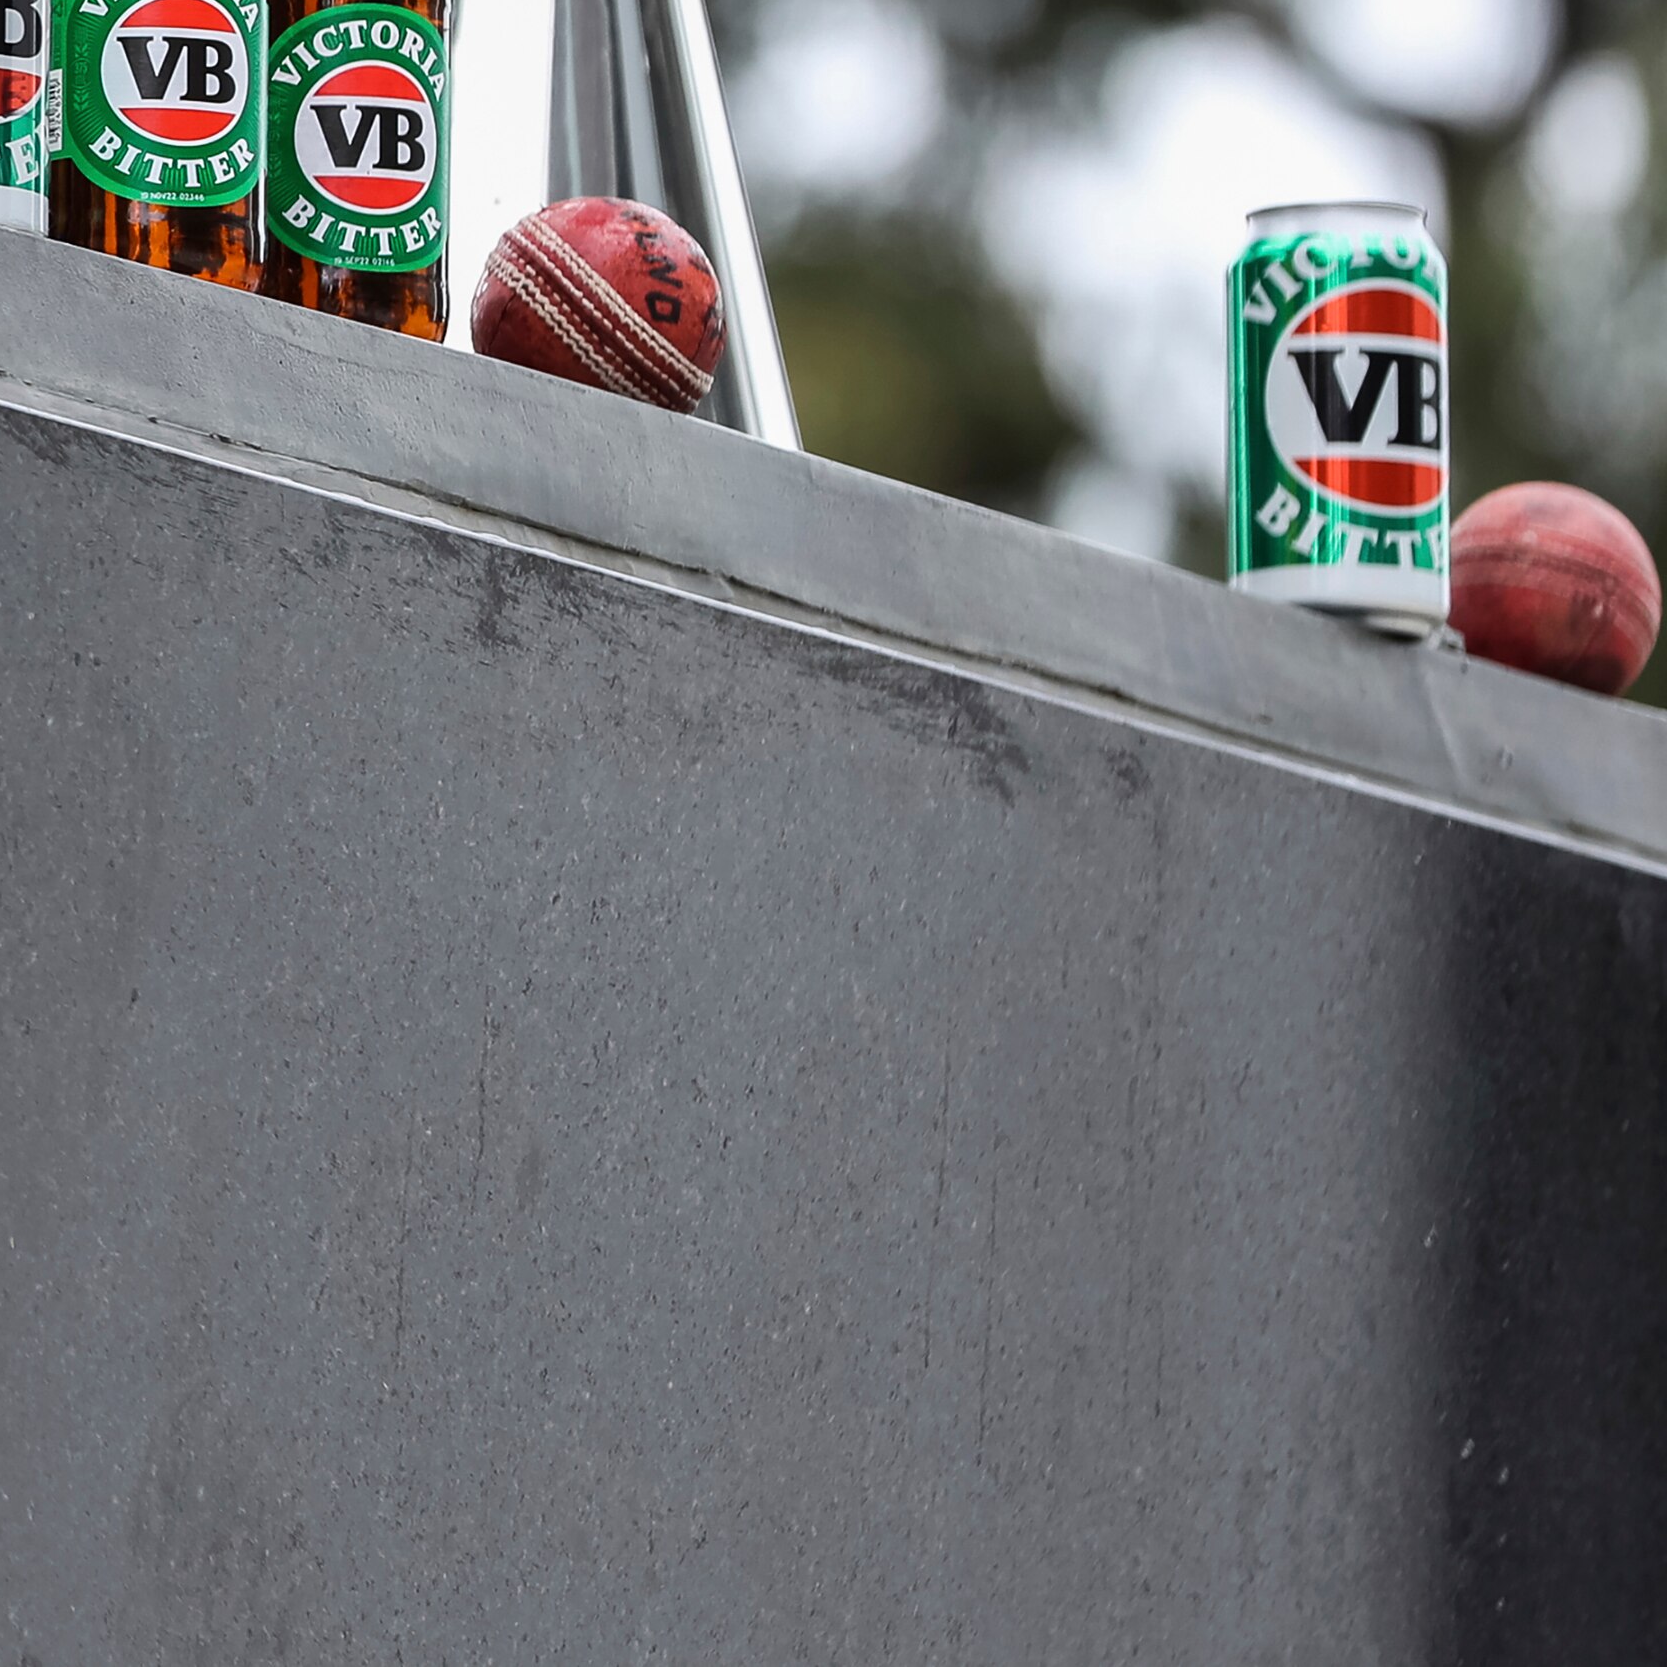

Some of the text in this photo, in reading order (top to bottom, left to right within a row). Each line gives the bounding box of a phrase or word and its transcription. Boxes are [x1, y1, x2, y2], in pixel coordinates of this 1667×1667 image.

[116, 36, 236, 104] VB
[271, 20, 447, 101] VICTORIA
[88, 126, 255, 188] BITTER
[310, 104, 425, 172] VB
[282, 195, 442, 256] BITTER
[1288, 346, 1441, 449] VB
